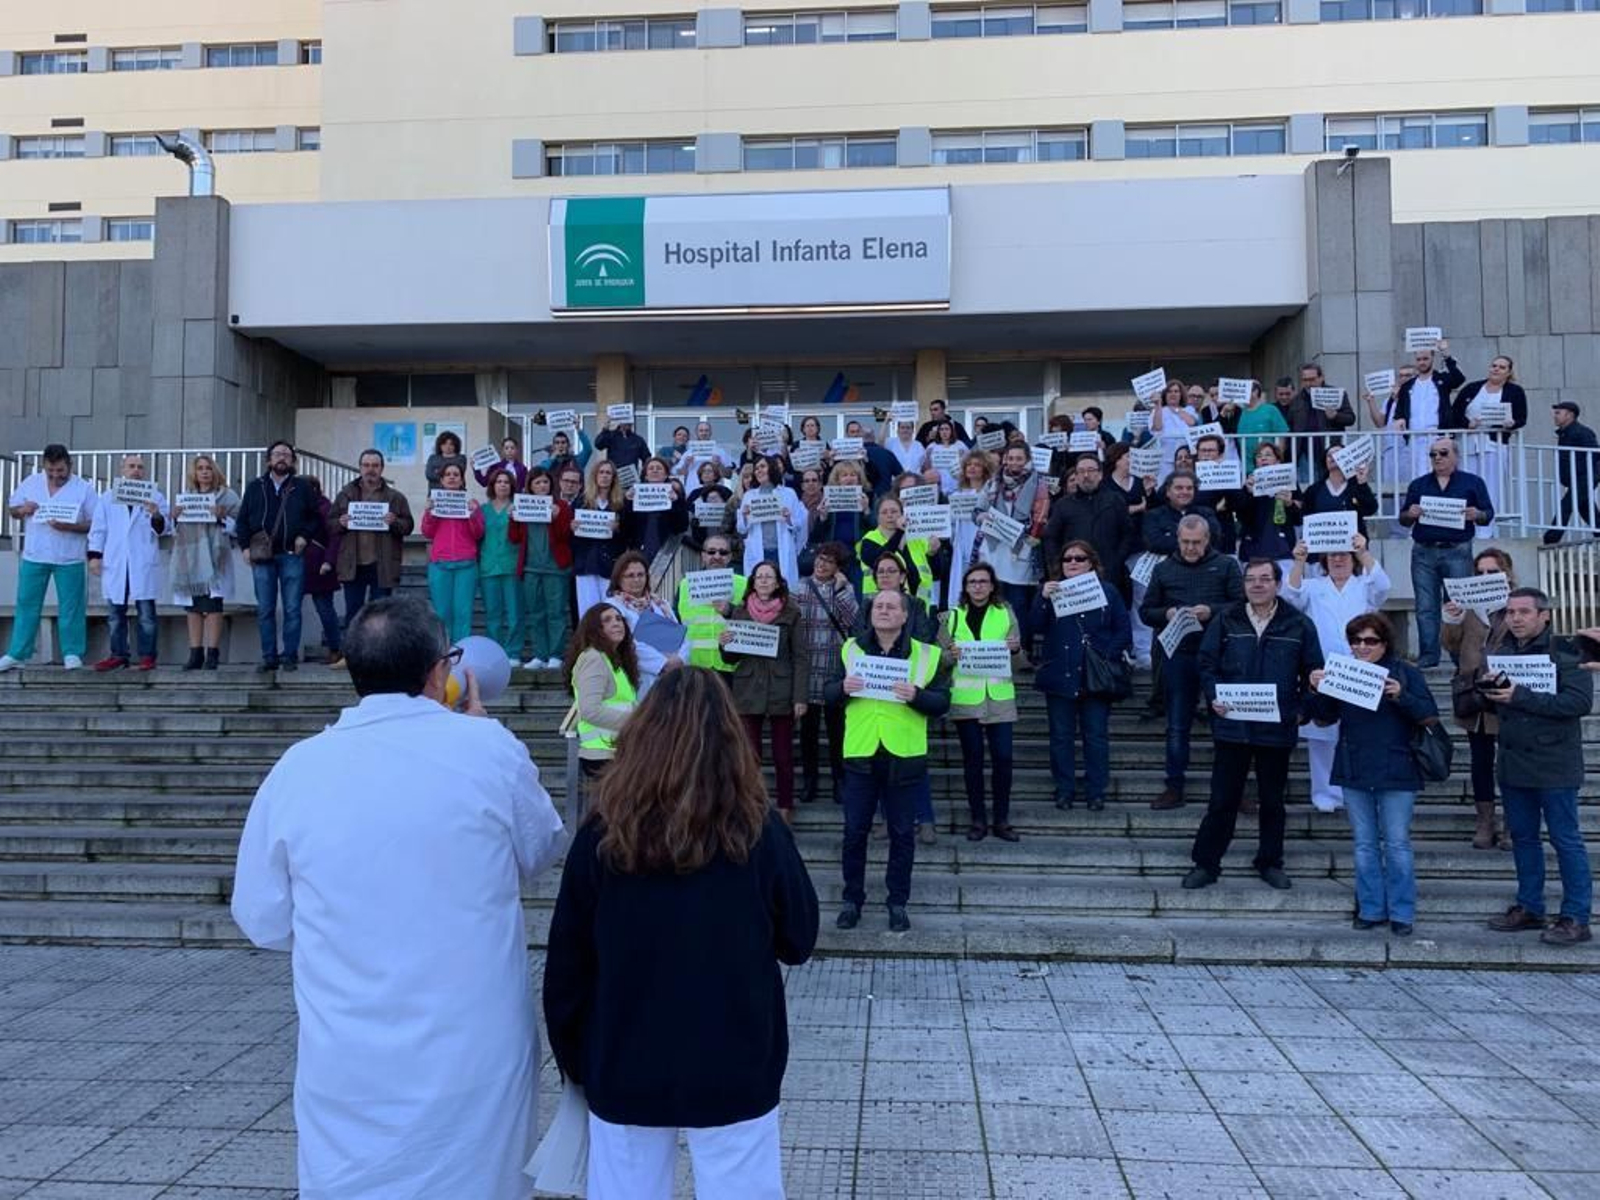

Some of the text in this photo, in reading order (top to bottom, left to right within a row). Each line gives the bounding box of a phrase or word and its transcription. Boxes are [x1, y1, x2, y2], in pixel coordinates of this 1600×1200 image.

[664, 236, 928, 269] Hospital Infanta Elena
[1308, 520, 1338, 528] CONTRA
[1462, 586, 1508, 596] TRANSPORTE
[1068, 594, 1100, 607] CUANDO?
[1467, 594, 1506, 604] CUANDO?
[739, 632, 778, 640] TRANSPORTE
[885, 665, 908, 673] ENERO
[865, 672, 908, 683] TRANSPORTE
[1360, 668, 1385, 682] ENERO
[1338, 672, 1382, 691] TRANSPORTE
[1324, 678, 1376, 700] PA CUANDO?
